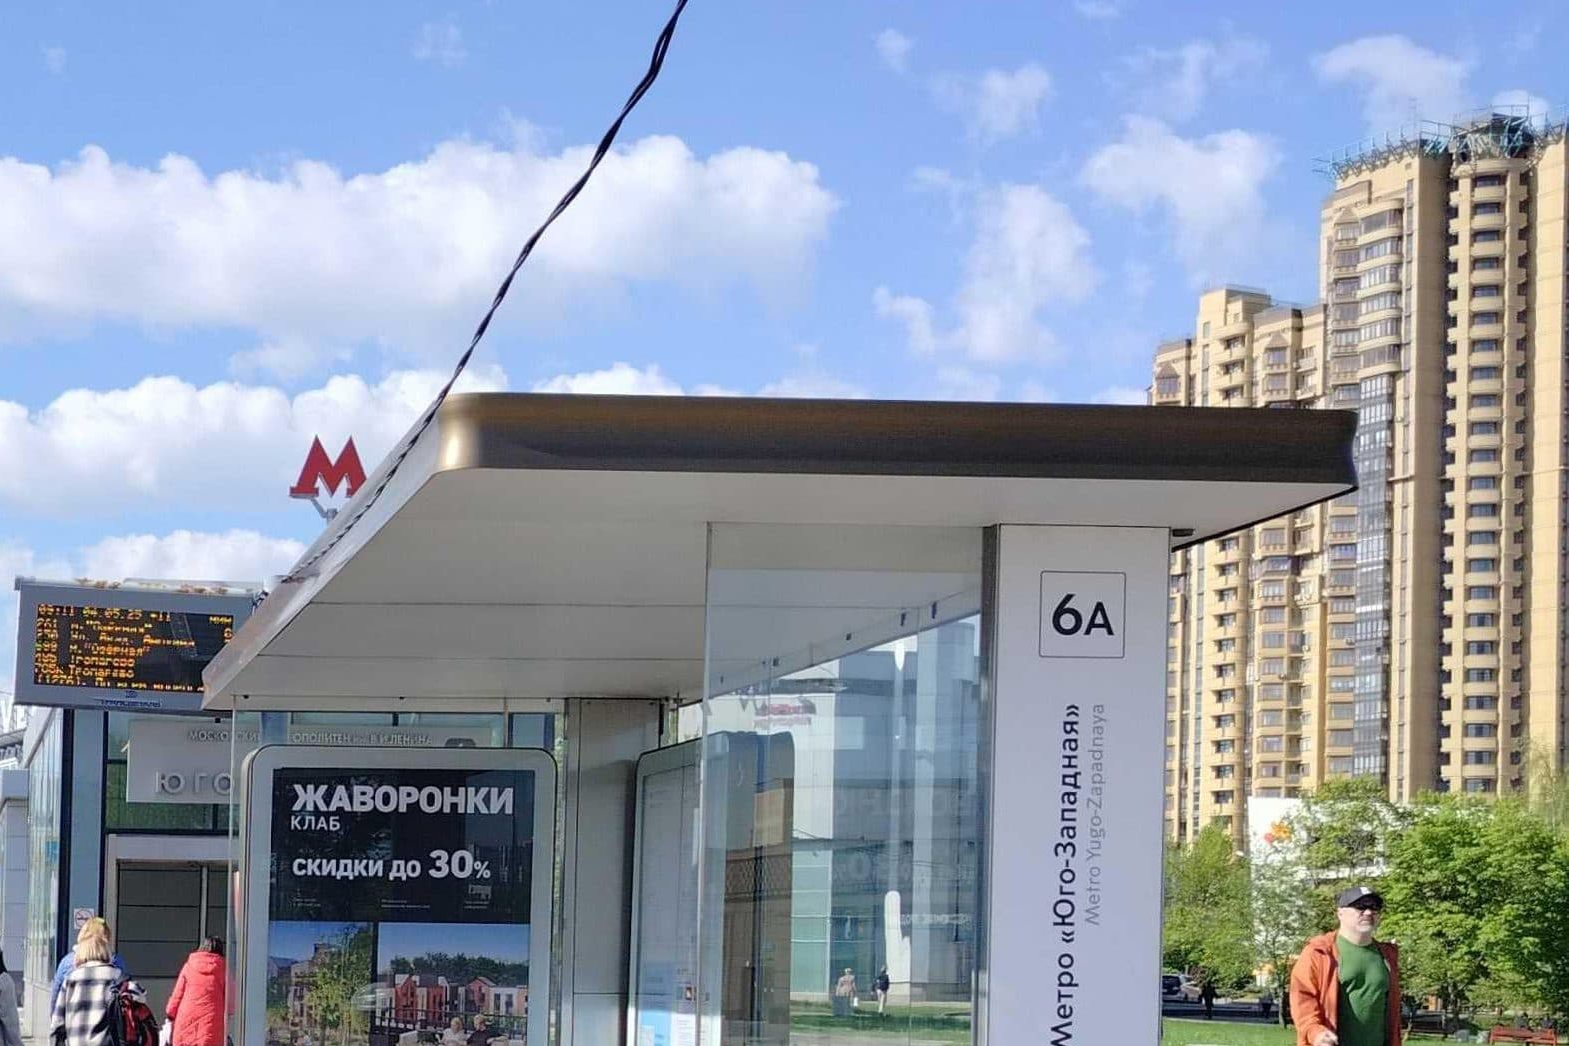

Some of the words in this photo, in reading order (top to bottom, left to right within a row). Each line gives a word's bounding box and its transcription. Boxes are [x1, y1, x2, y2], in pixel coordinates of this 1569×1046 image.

[289, 435, 367, 498] М
[1051, 593, 1114, 637] 6А
[292, 784, 514, 814] ЖАВОРОНКИ
[1087, 704, 1106, 861] Yugo-Zapadnaya
[290, 816, 341, 831] КЛАБ
[1053, 704, 1081, 944] «Юго-Западная»
[429, 850, 491, 879] 30%
[1084, 866, 1101, 926] Metro
